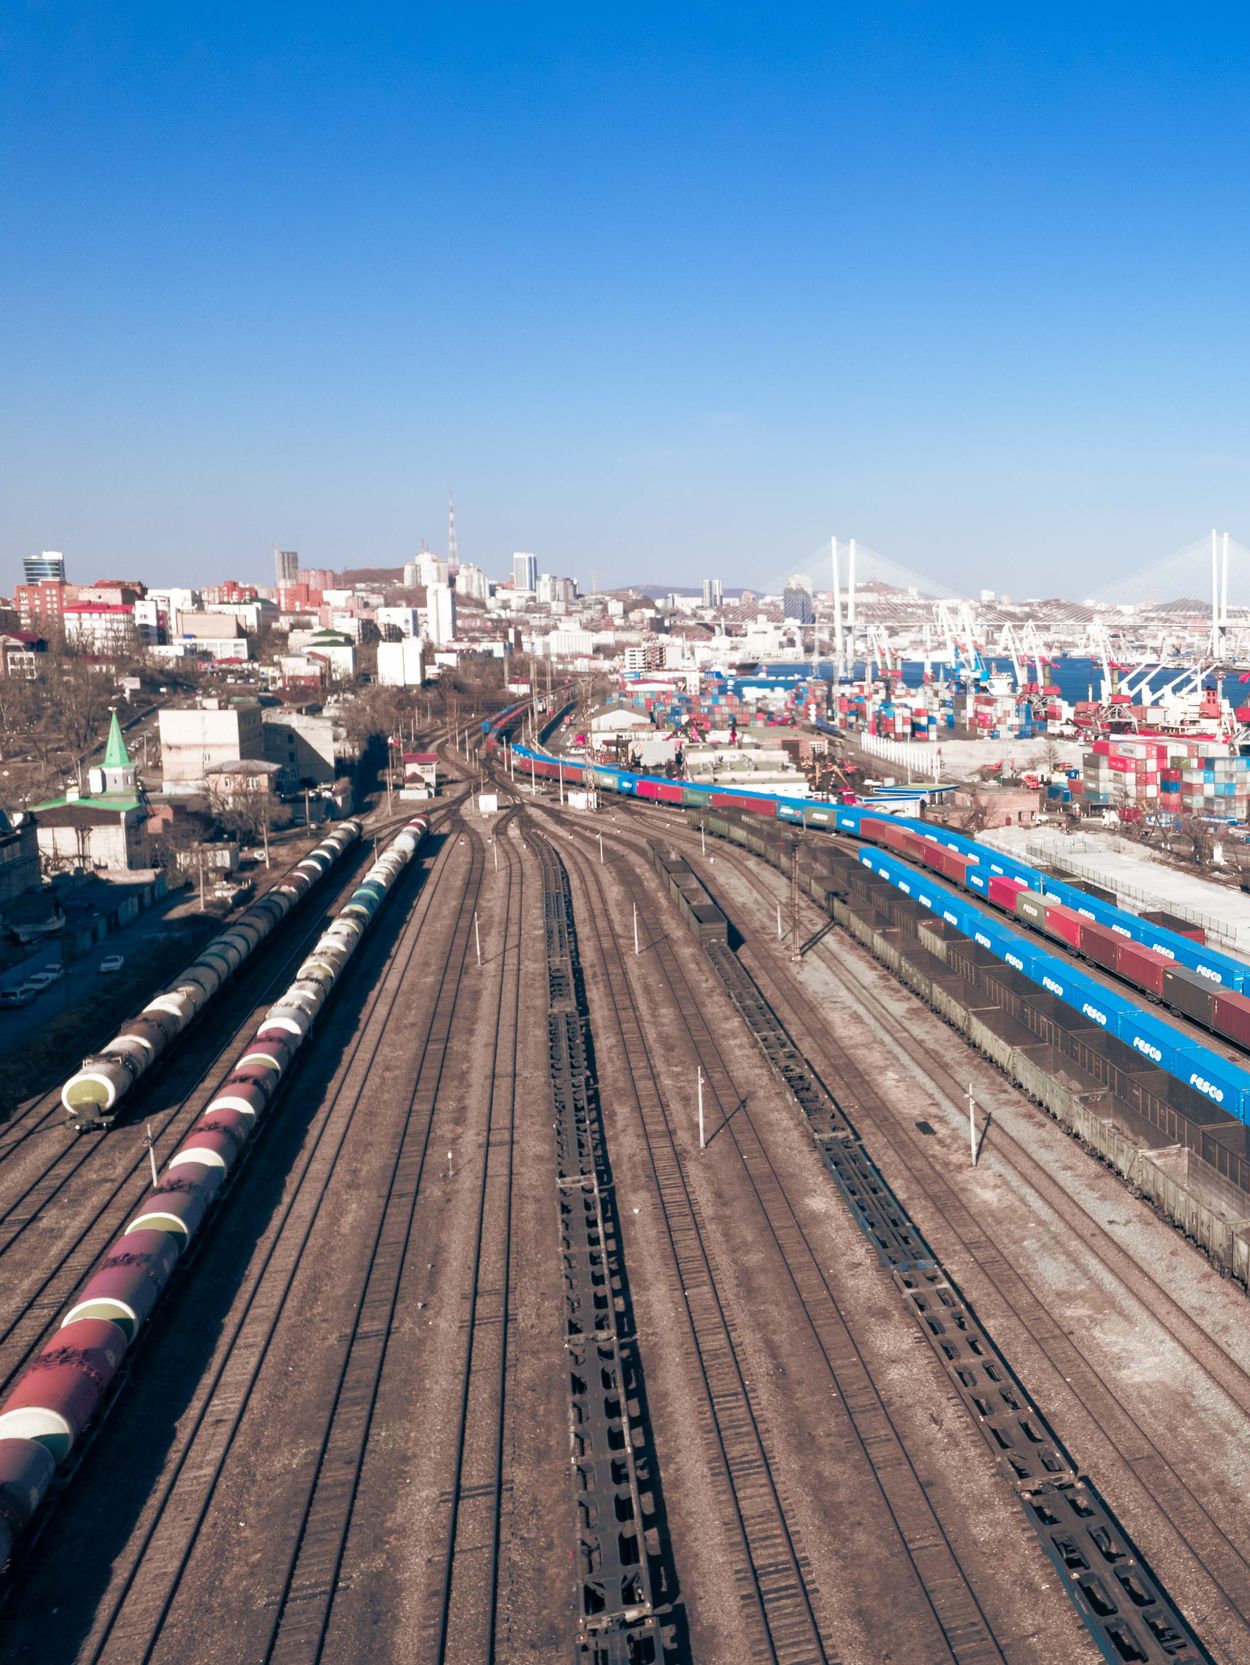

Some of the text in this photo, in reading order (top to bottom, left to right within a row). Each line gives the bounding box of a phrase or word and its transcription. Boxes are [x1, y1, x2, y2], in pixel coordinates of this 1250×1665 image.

[1196, 964, 1222, 984] FESCO
[1043, 977, 1063, 995] FESCO
[1083, 1004, 1106, 1025] FESCO
[1134, 1037, 1161, 1061] FESCO
[1190, 1074, 1223, 1101] FESCO
